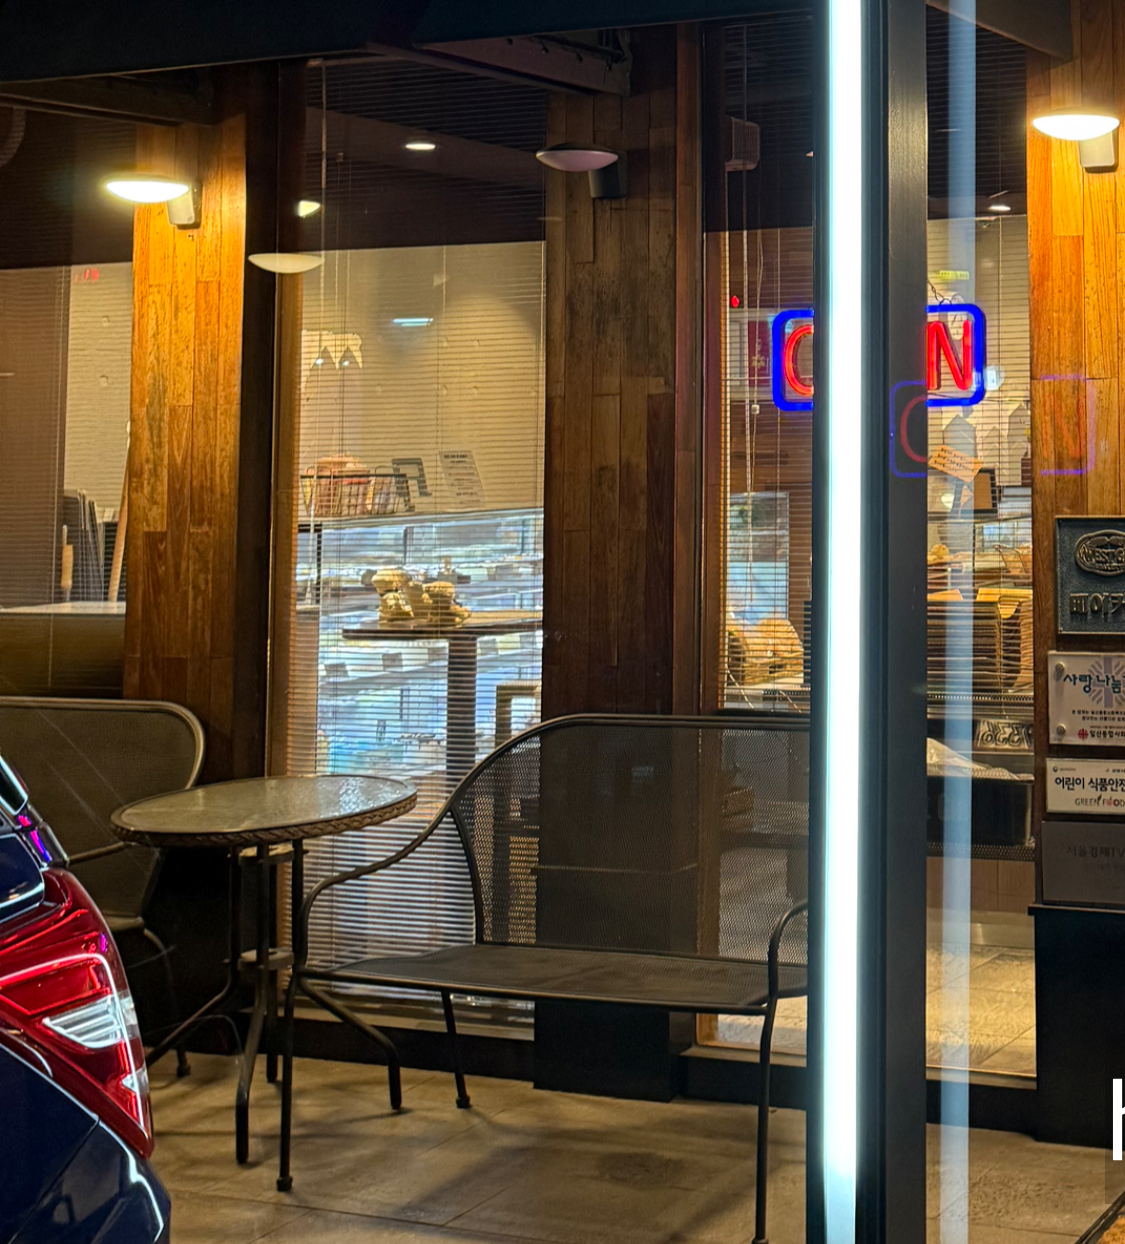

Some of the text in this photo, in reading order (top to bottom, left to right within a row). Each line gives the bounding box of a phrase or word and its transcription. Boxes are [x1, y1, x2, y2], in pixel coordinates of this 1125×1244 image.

[1054, 776, 1085, 791] 어린이
[1075, 796, 1101, 807] GREEN
[1102, 796, 1125, 808] FOOD
